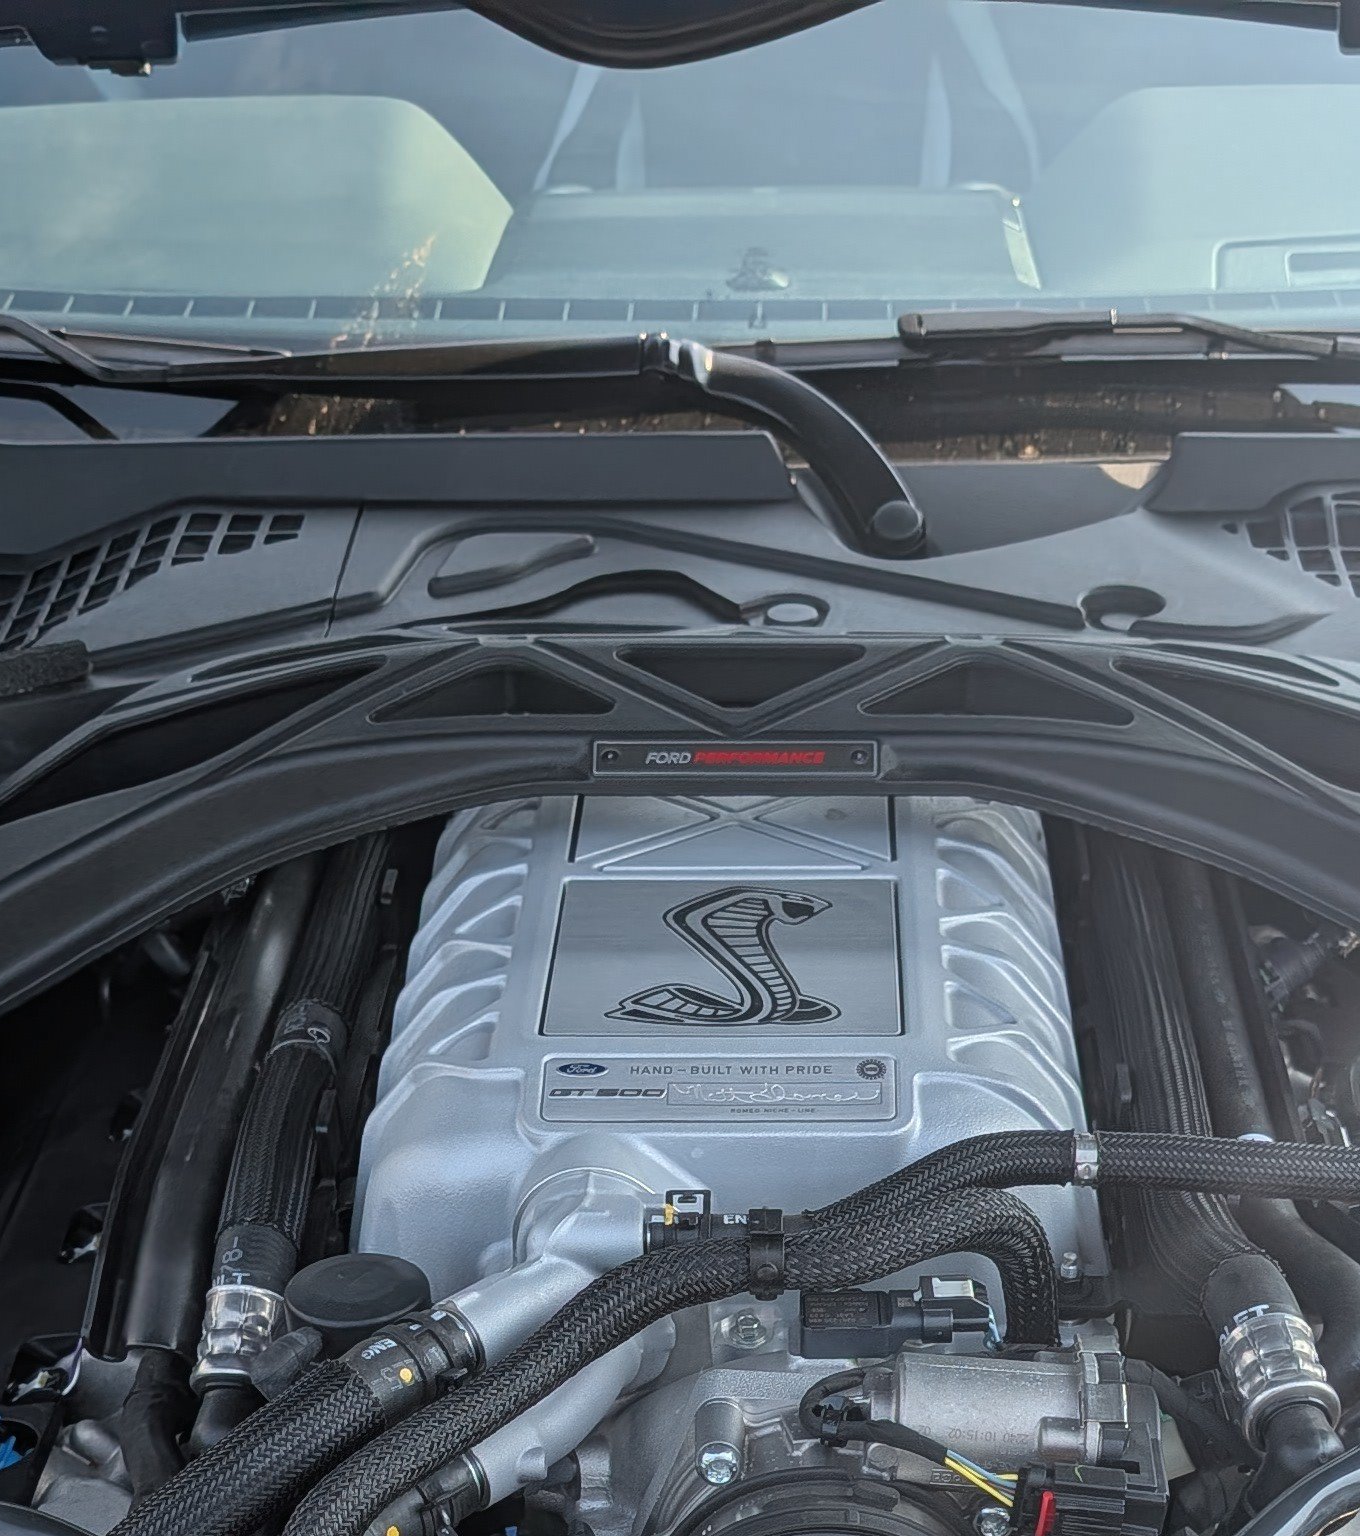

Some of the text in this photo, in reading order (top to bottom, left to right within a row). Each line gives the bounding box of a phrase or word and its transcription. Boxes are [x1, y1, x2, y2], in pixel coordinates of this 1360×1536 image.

[645, 750, 826, 766] FORD PERFORMANCE
[562, 1063, 600, 1076] Ford
[630, 1065, 673, 1076] HAND
[690, 1065, 733, 1076] BUILT
[740, 1065, 780, 1076] WITH
[785, 1065, 833, 1076] PRIDE
